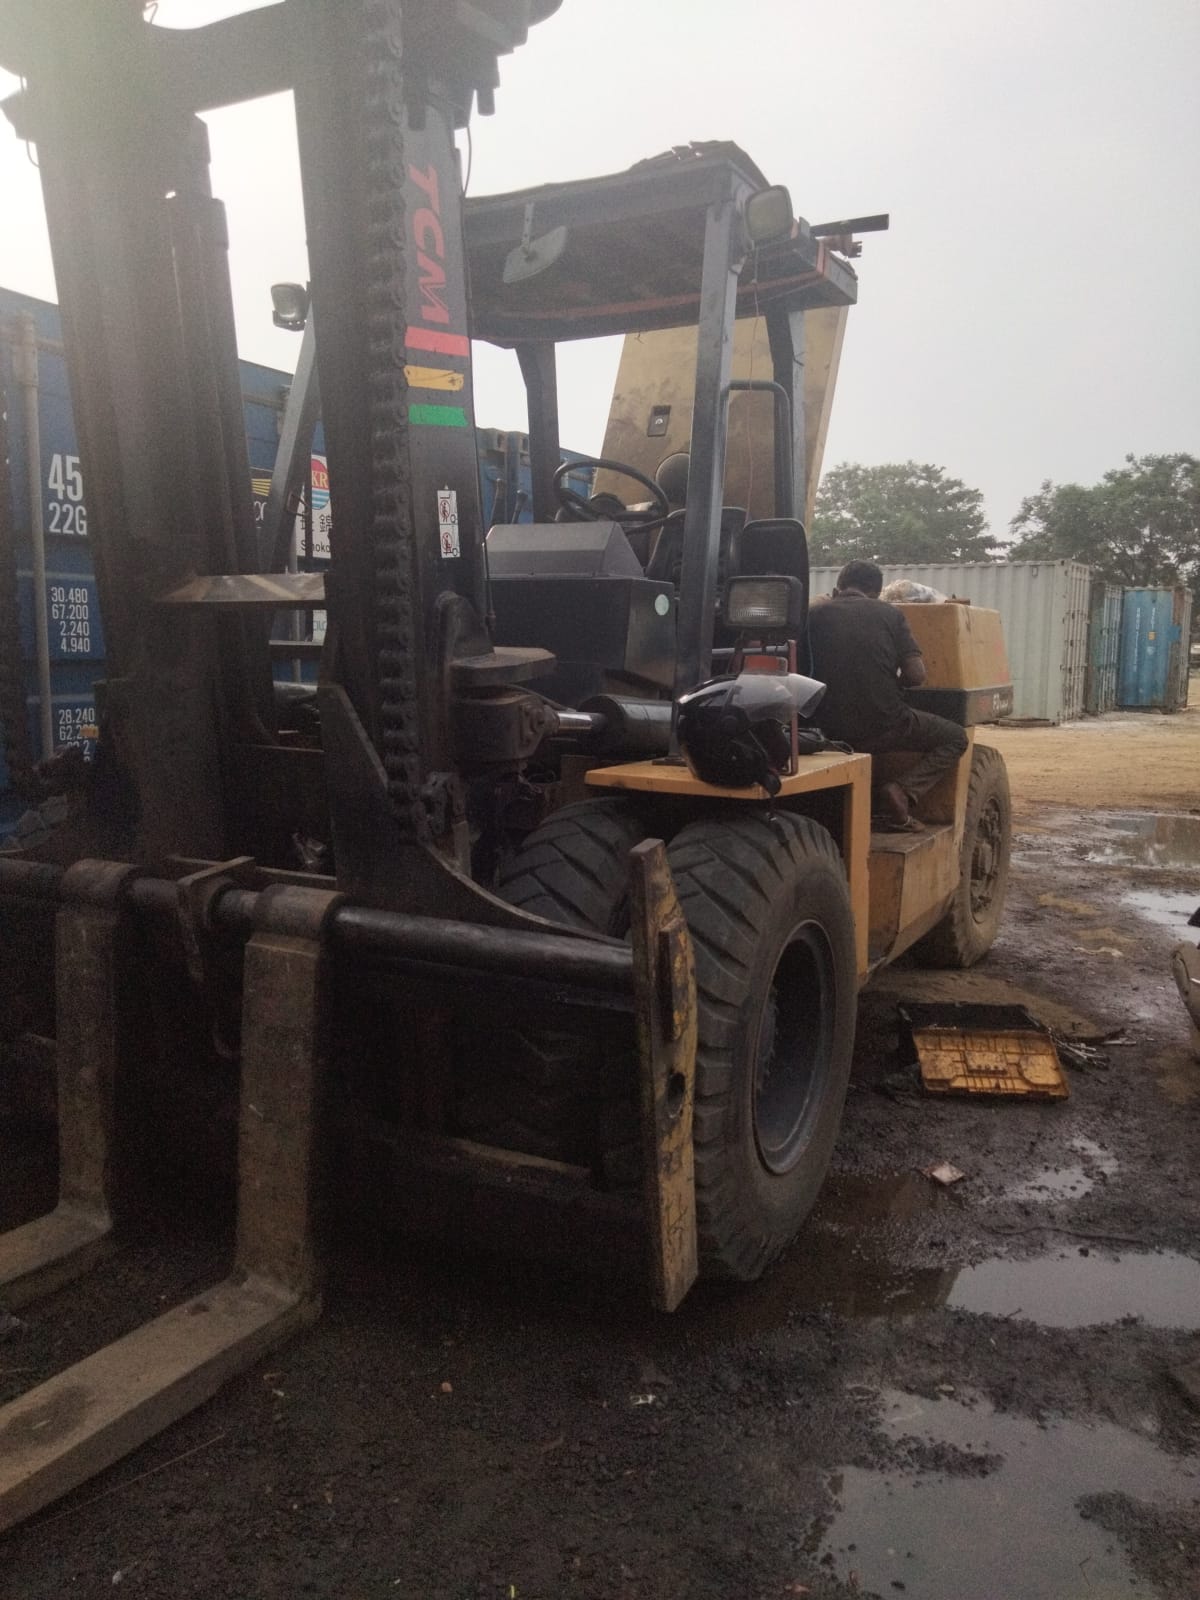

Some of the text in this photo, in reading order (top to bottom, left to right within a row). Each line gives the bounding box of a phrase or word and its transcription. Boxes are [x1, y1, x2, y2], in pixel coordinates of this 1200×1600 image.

[48, 453, 84, 502] 45
[49, 502, 88, 537] 22G
[51, 586, 88, 604] 30.480
[52, 603, 89, 620] 67.200
[60, 620, 90, 636] 2.240
[61, 637, 90, 653] 4.940
[58, 707, 95, 725] 28.240
[59, 724, 98, 741] 62.2
